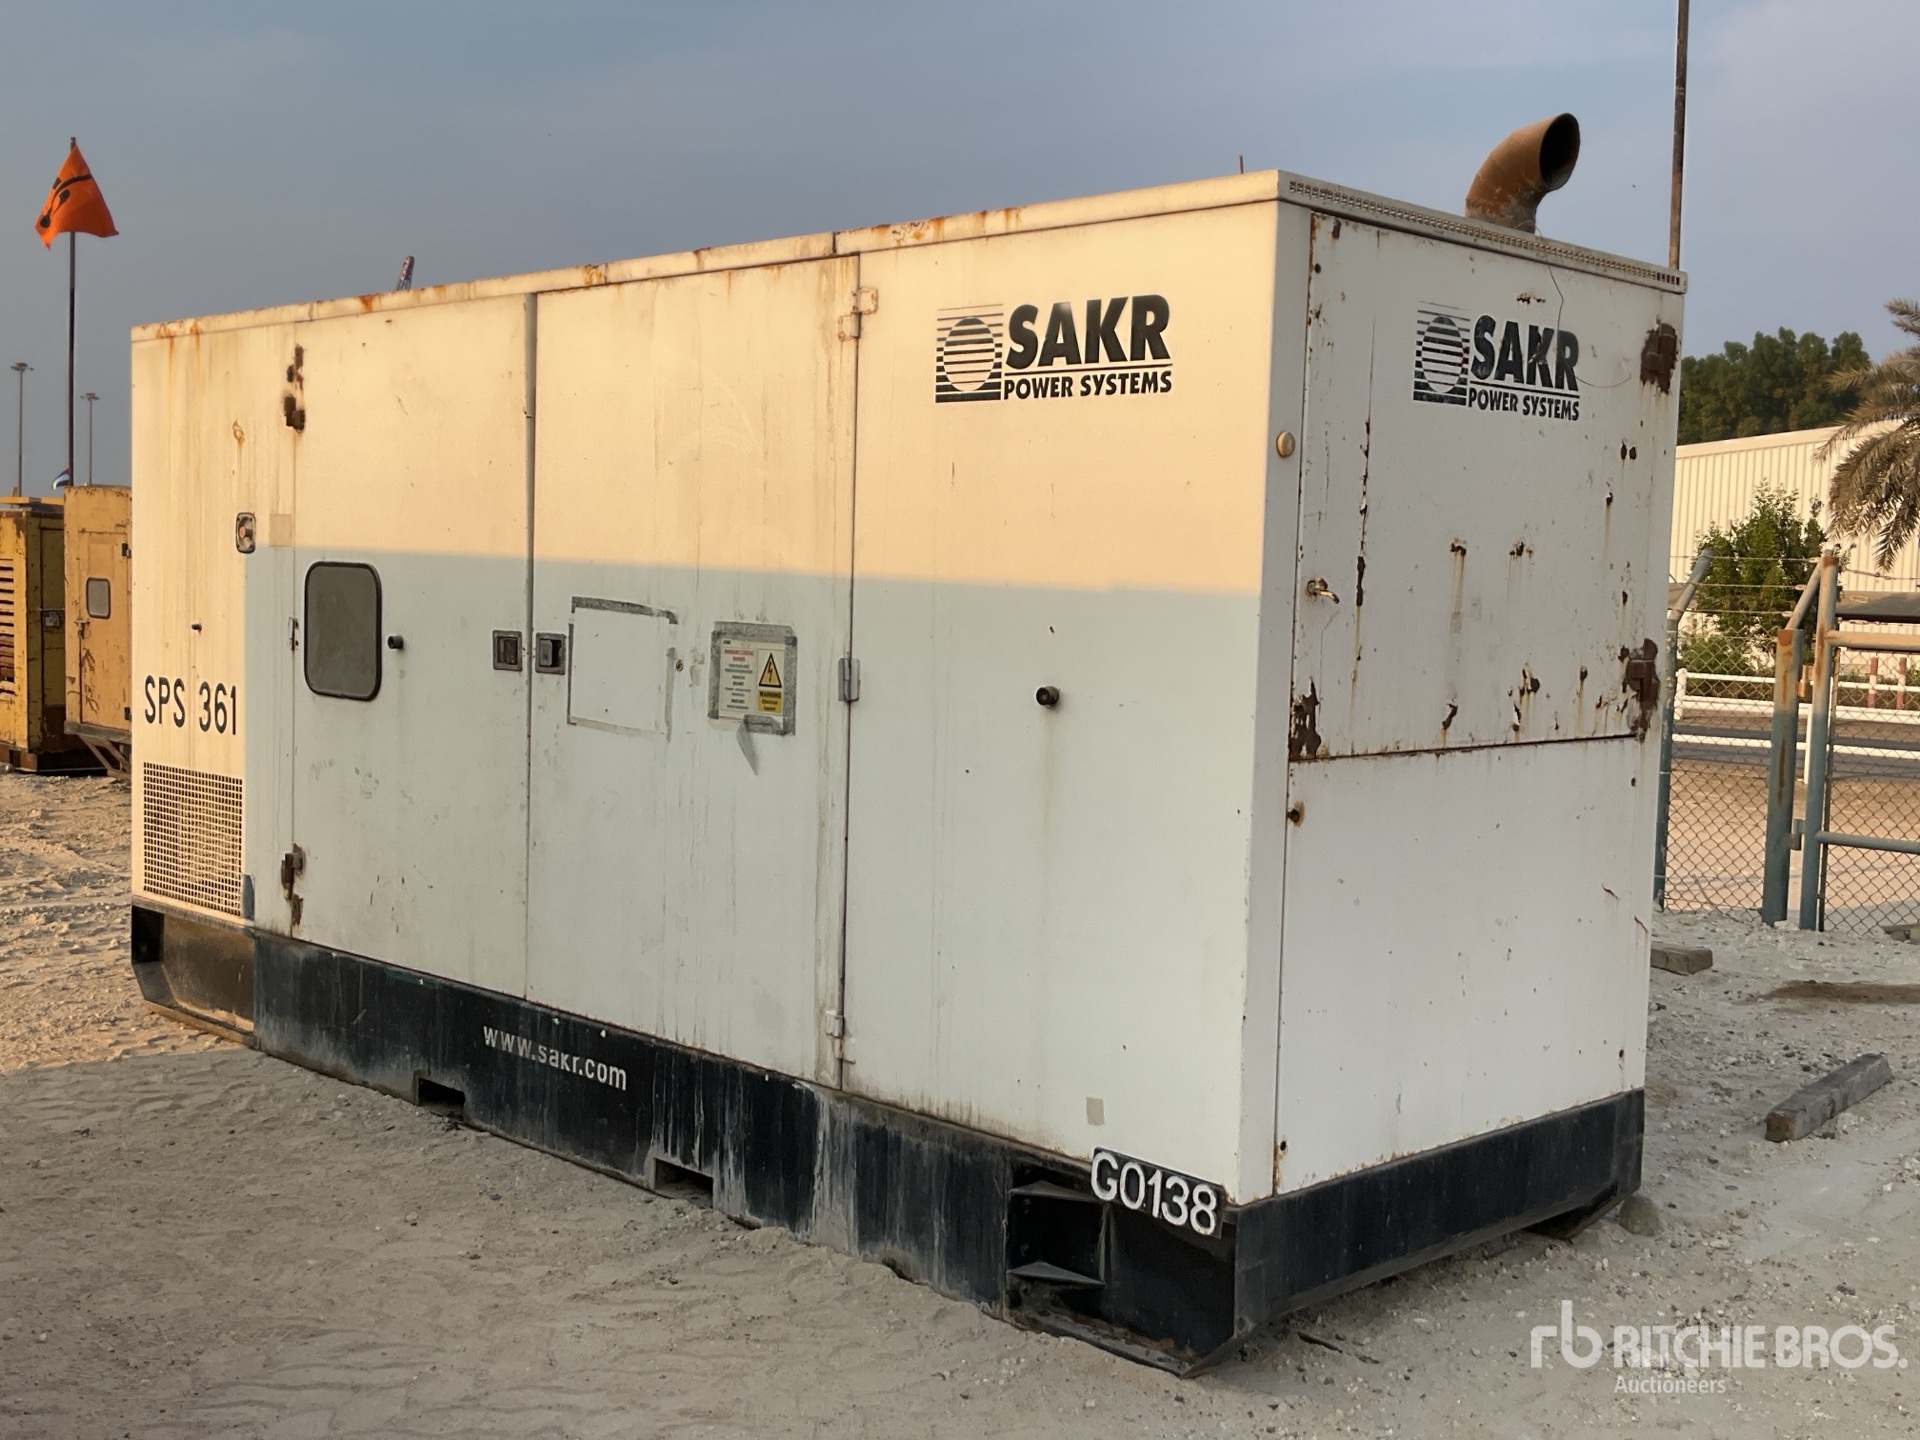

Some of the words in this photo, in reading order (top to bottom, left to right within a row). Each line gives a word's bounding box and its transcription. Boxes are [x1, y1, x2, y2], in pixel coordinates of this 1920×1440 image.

[1005, 294, 1171, 370] SAKR
[1470, 315, 1580, 392] SAKR
[1003, 375, 1074, 400] POWER
[1080, 371, 1172, 397] SYSTEMS
[1468, 387, 1518, 412] POWER
[1522, 395, 1580, 421] SYSTEMS
[144, 674, 186, 728] SPS
[198, 681, 236, 735] 361
[483, 1025, 627, 1091] www.sakr.com
